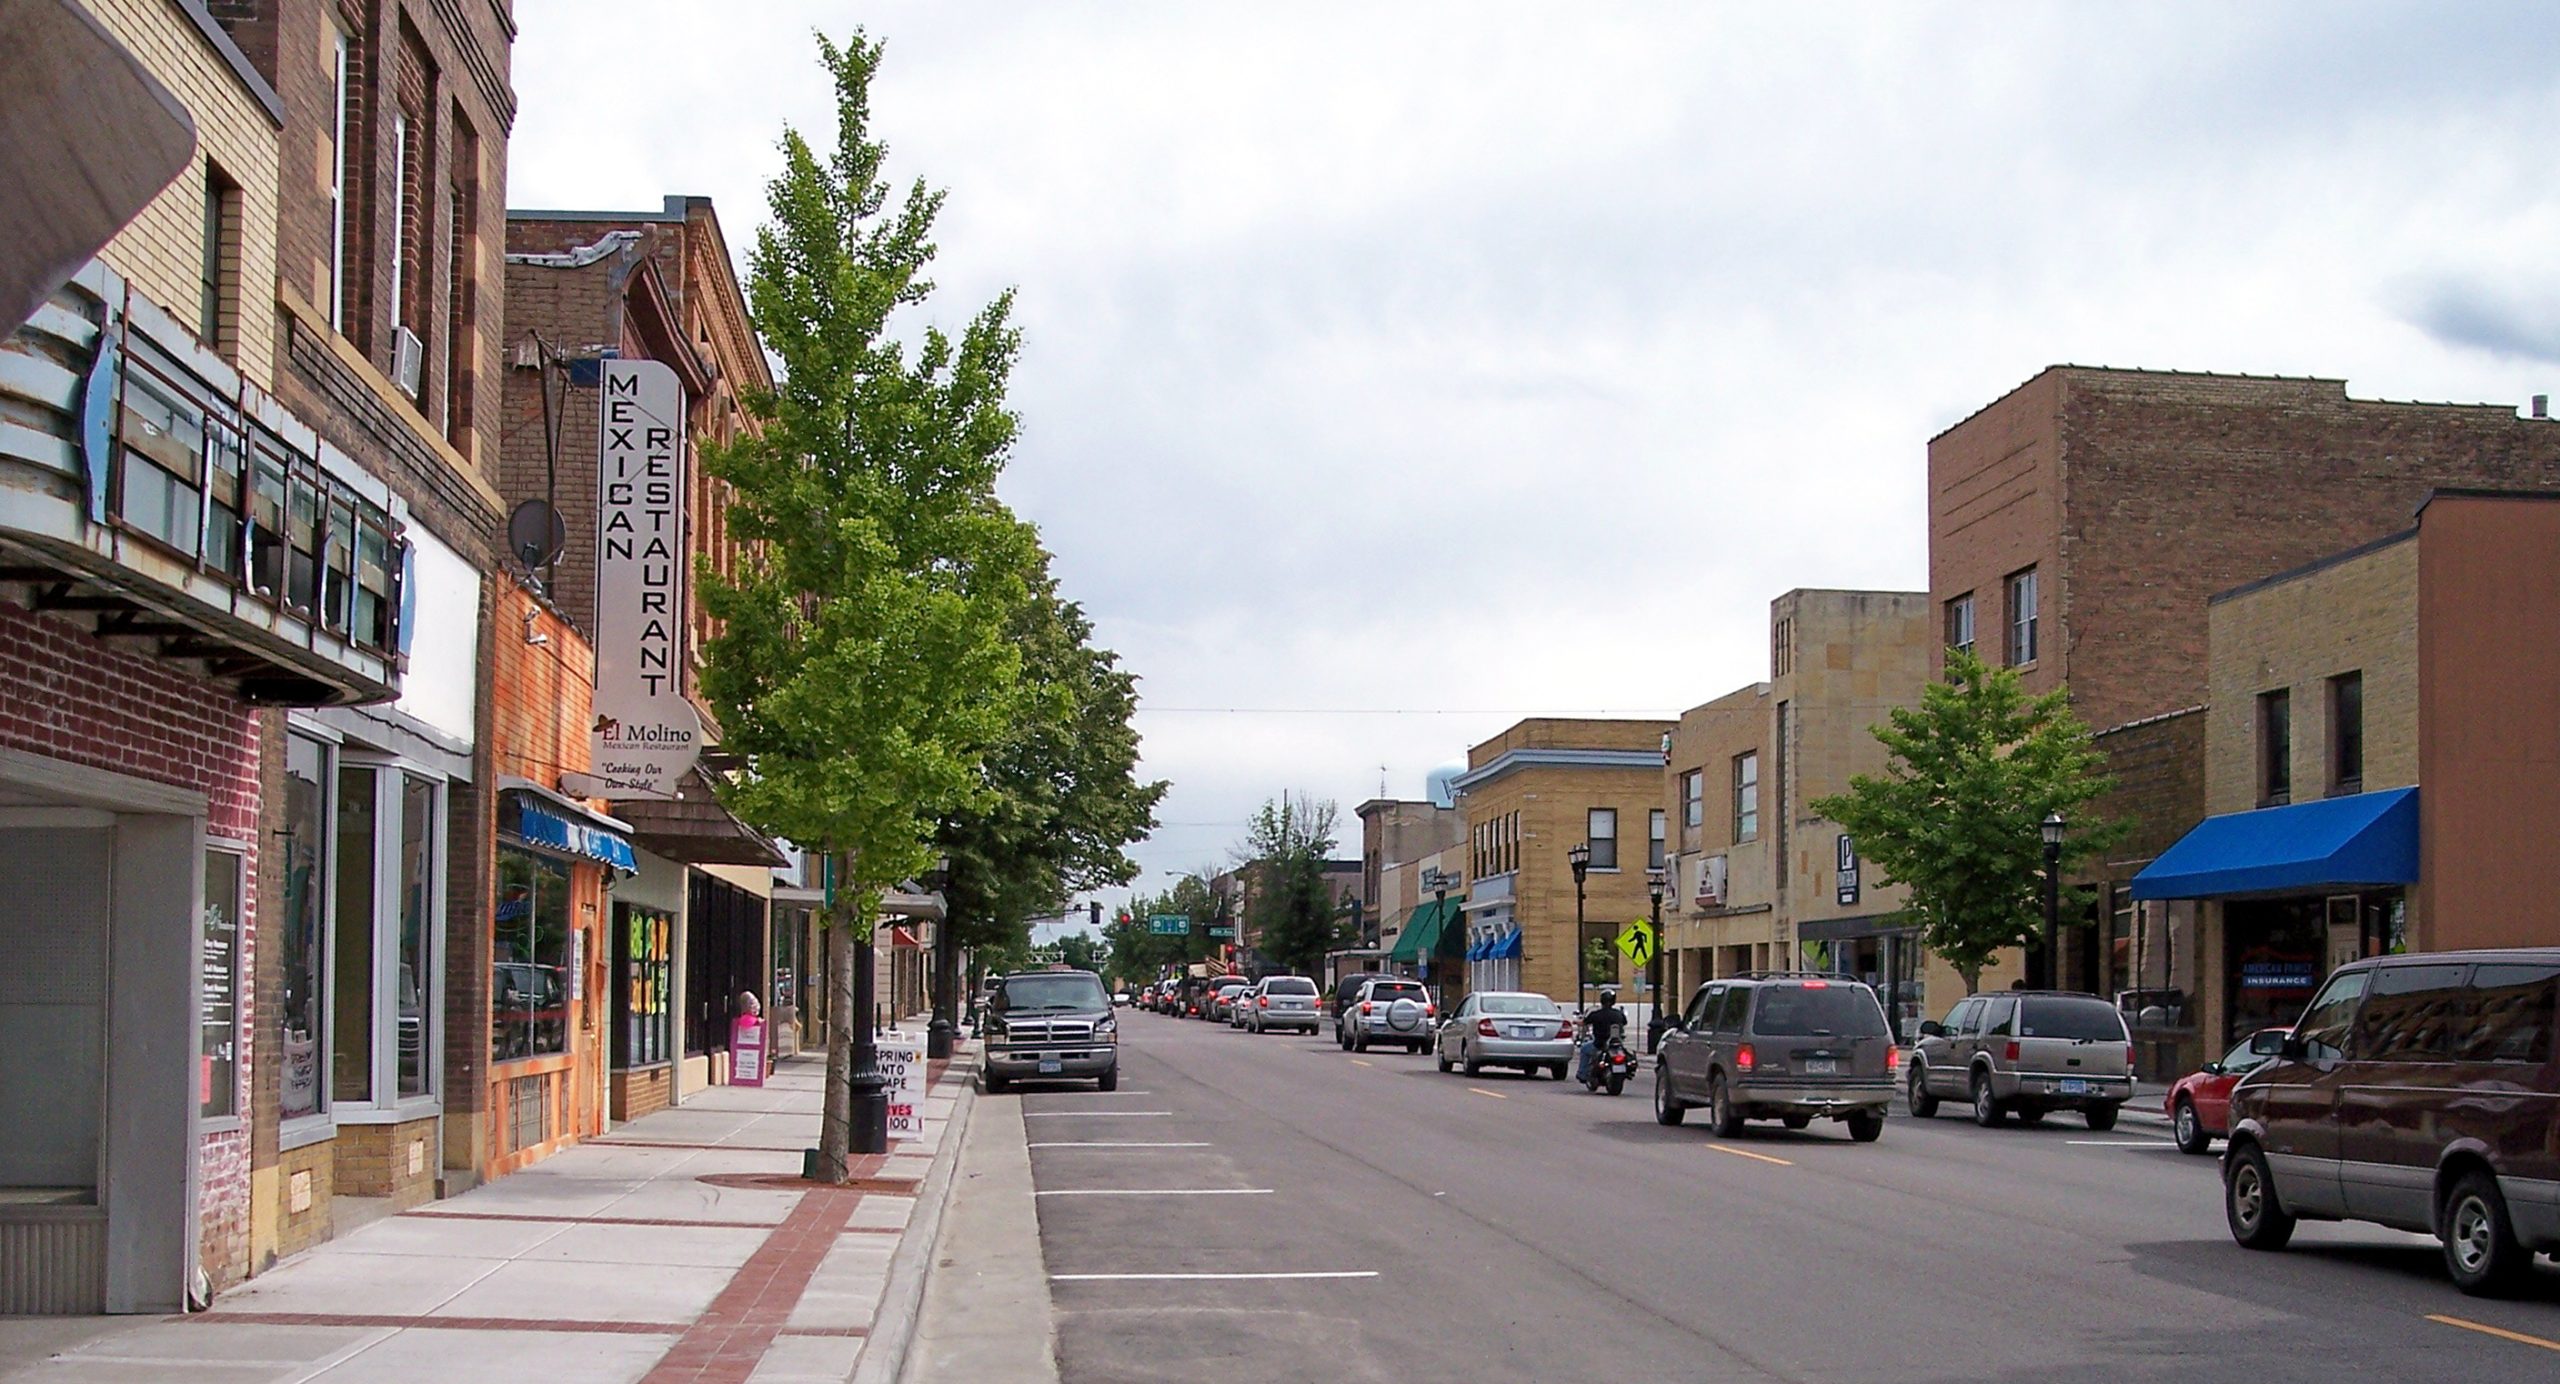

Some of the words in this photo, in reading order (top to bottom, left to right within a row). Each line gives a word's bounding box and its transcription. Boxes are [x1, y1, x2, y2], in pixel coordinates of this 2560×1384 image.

[605, 373, 638, 561] MEXICAN
[640, 427, 671, 697] RESTAURANT
[602, 722, 620, 741] El
[627, 723, 692, 742] Molino
[603, 741, 640, 751] Mexican
[642, 741, 689, 751] Restaurant
[645, 763, 662, 775] Our
[2247, 977, 2307, 985] INSURANCE
